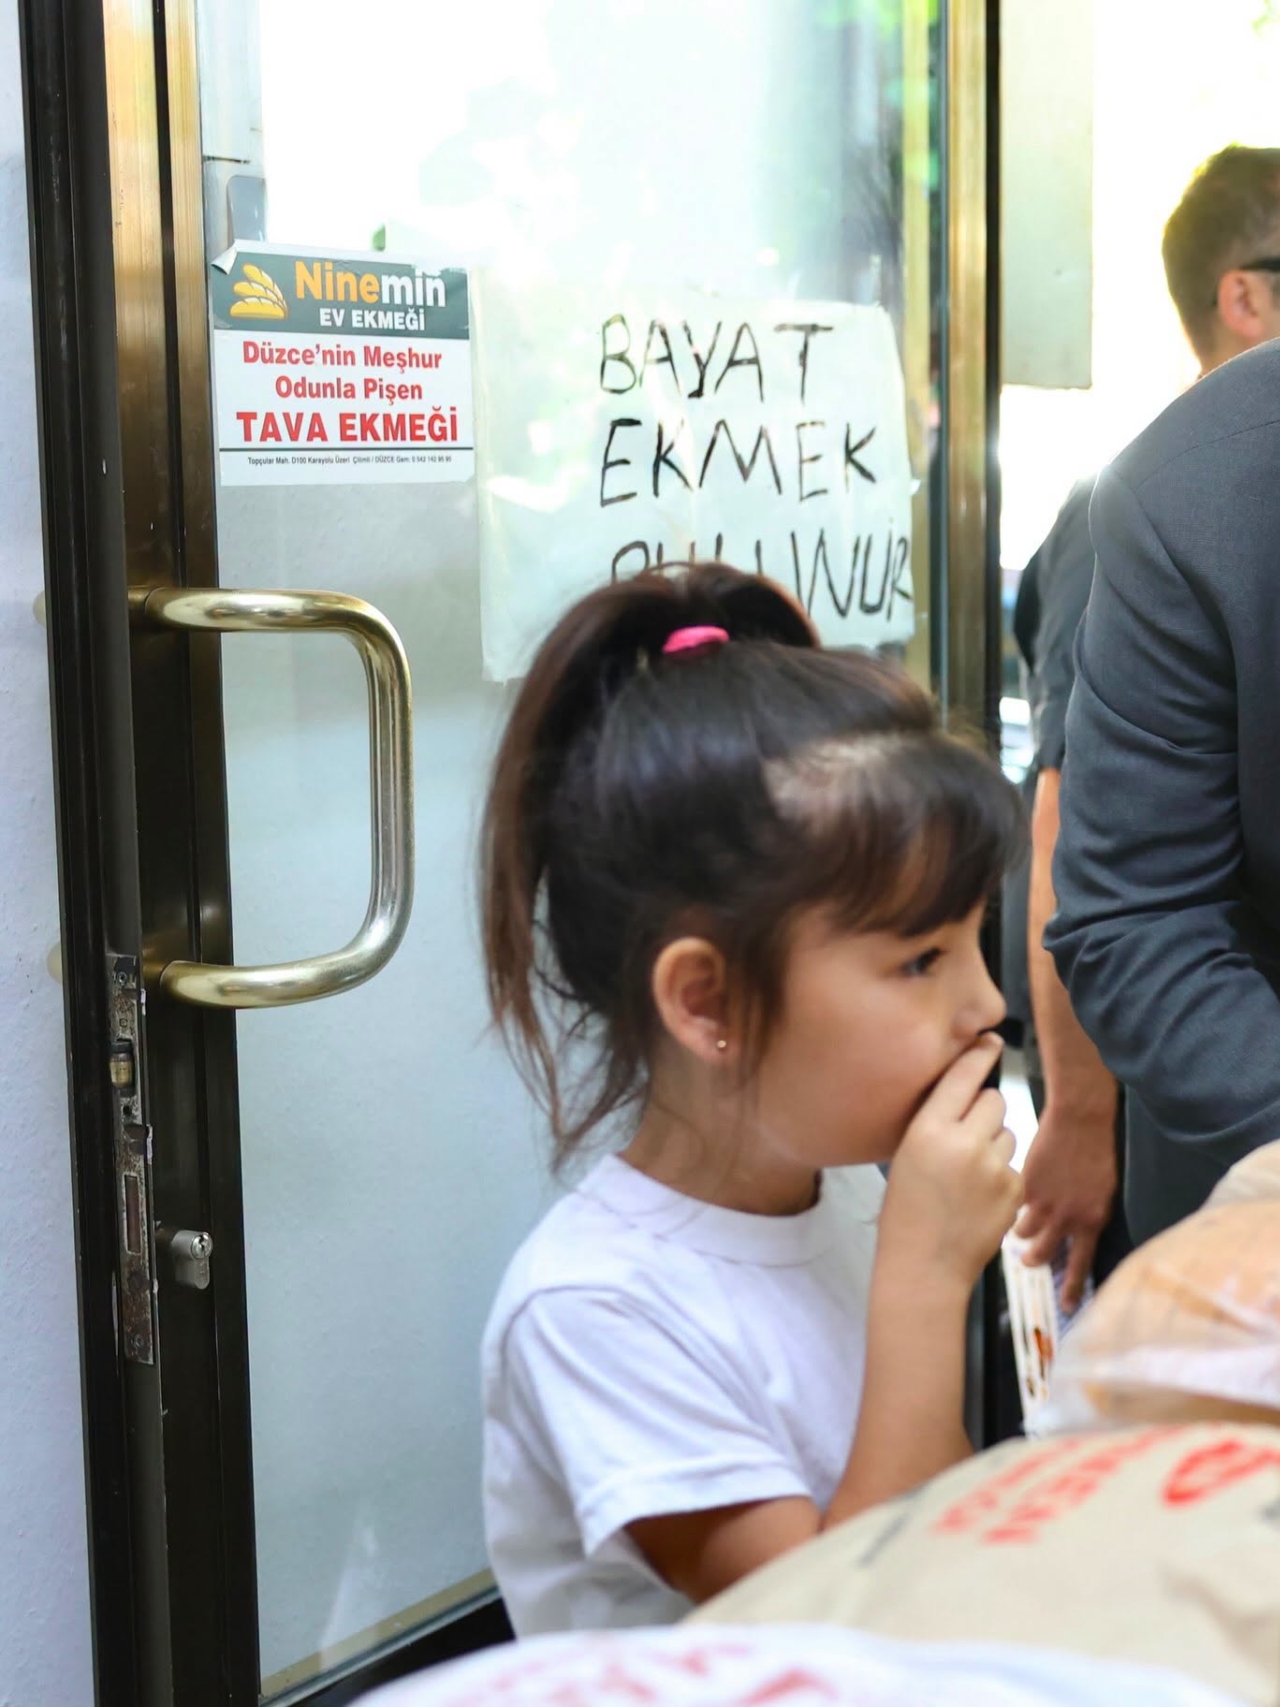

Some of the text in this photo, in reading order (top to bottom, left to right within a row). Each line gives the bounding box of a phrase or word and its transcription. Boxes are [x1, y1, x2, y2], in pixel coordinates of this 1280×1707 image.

[295, 261, 446, 307] Ninemin
[319, 308, 425, 331] EV EKMEĞİ
[363, 345, 442, 374] Meşhur
[599, 313, 834, 404] BAYAT
[276, 376, 423, 405] Odunla Pişen
[236, 406, 458, 442] TAVA EKMEĞİ
[599, 418, 877, 507] EKMEK
